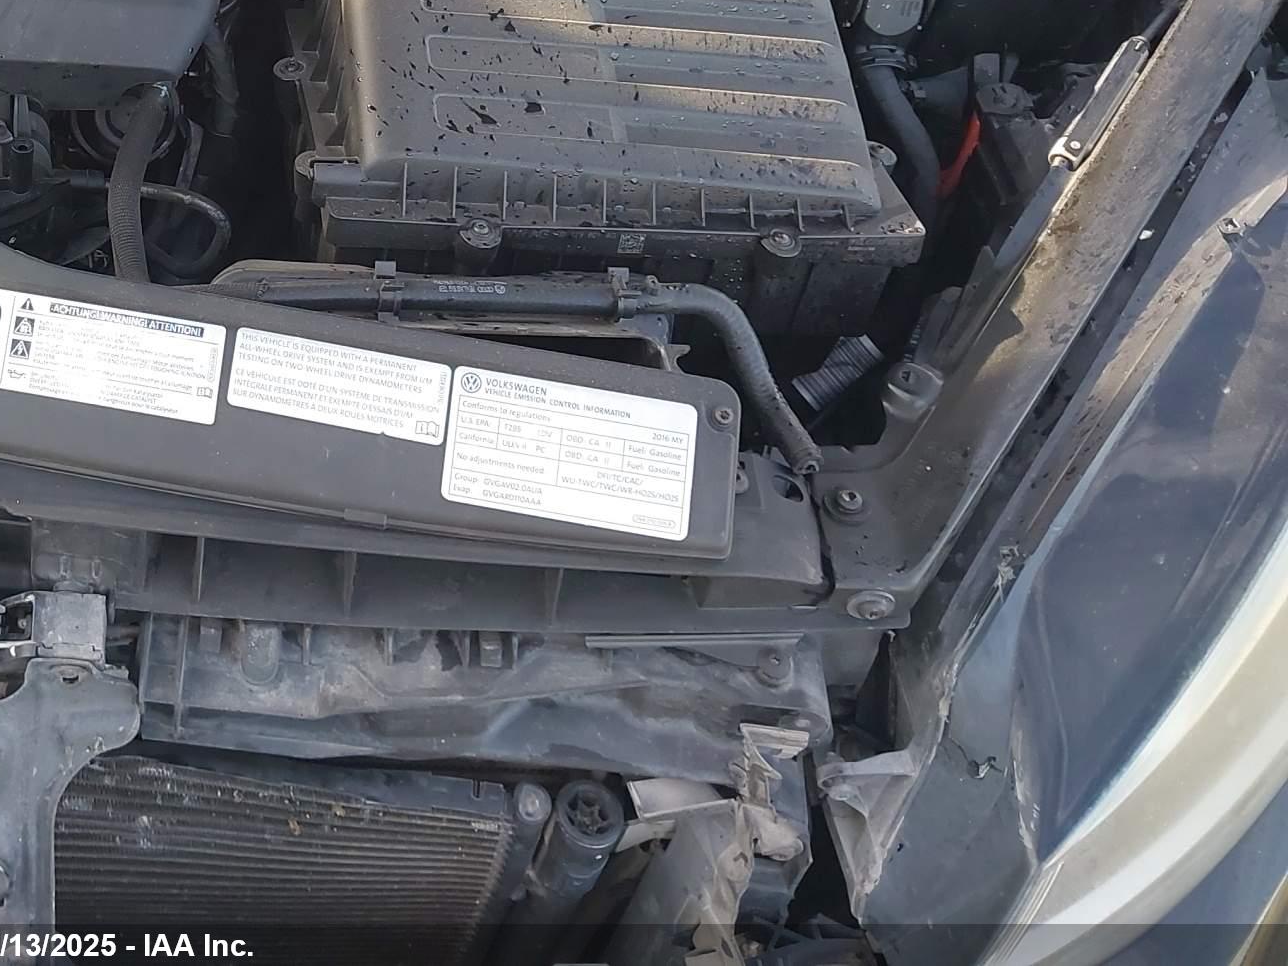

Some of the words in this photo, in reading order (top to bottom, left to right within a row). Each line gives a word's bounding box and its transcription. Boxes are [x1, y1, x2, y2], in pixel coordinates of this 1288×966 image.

[149, 321, 202, 336] ATTENTION!
[241, 332, 258, 342] THIS
[259, 336, 290, 348] VEHICLE
[300, 343, 338, 357] EQUIPPED
[340, 351, 361, 361] WITH
[371, 357, 416, 371] PERMANENT
[238, 352, 269, 364] TESTING
[270, 358, 282, 366] ON
[334, 370, 356, 380] DRIVE
[358, 374, 422, 392] DYNAMOMETERS
[282, 350, 303, 360] DRIVE
[307, 355, 334, 366] SYSTEM
[336, 360, 354, 370] AND
[365, 366, 393, 377] EXEMPT
[395, 371, 417, 382] FROM
[235, 368, 244, 376] CE
[283, 377, 295, 386] EST
[373, 393, 382, 402] DE
[384, 395, 439, 412] TRANSMISSION
[486, 378, 547, 395] VOLKSWAGEN
[233, 388, 246, 397] SUR
[318, 404, 338, 414] DEUX
[367, 413, 404, 427] MOTRICES
[462, 400, 497, 412] Conforms
[510, 408, 551, 423] regulations
[485, 388, 511, 398] VEHICLE
[514, 393, 546, 404] EMISSION
[549, 399, 580, 410] CONTROL
[583, 404, 630, 418] INFORMATION
[589, 438, 599, 446] CA
[652, 432, 669, 441] 2016
[672, 436, 683, 444] MY
[536, 445, 545, 453] PC
[587, 454, 598, 462] CA
[649, 448, 681, 460] Gasoline
[456, 452, 467, 460] No
[469, 455, 514, 469] adjustments
[517, 463, 544, 473] needed
[648, 464, 680, 476] Gasoline
